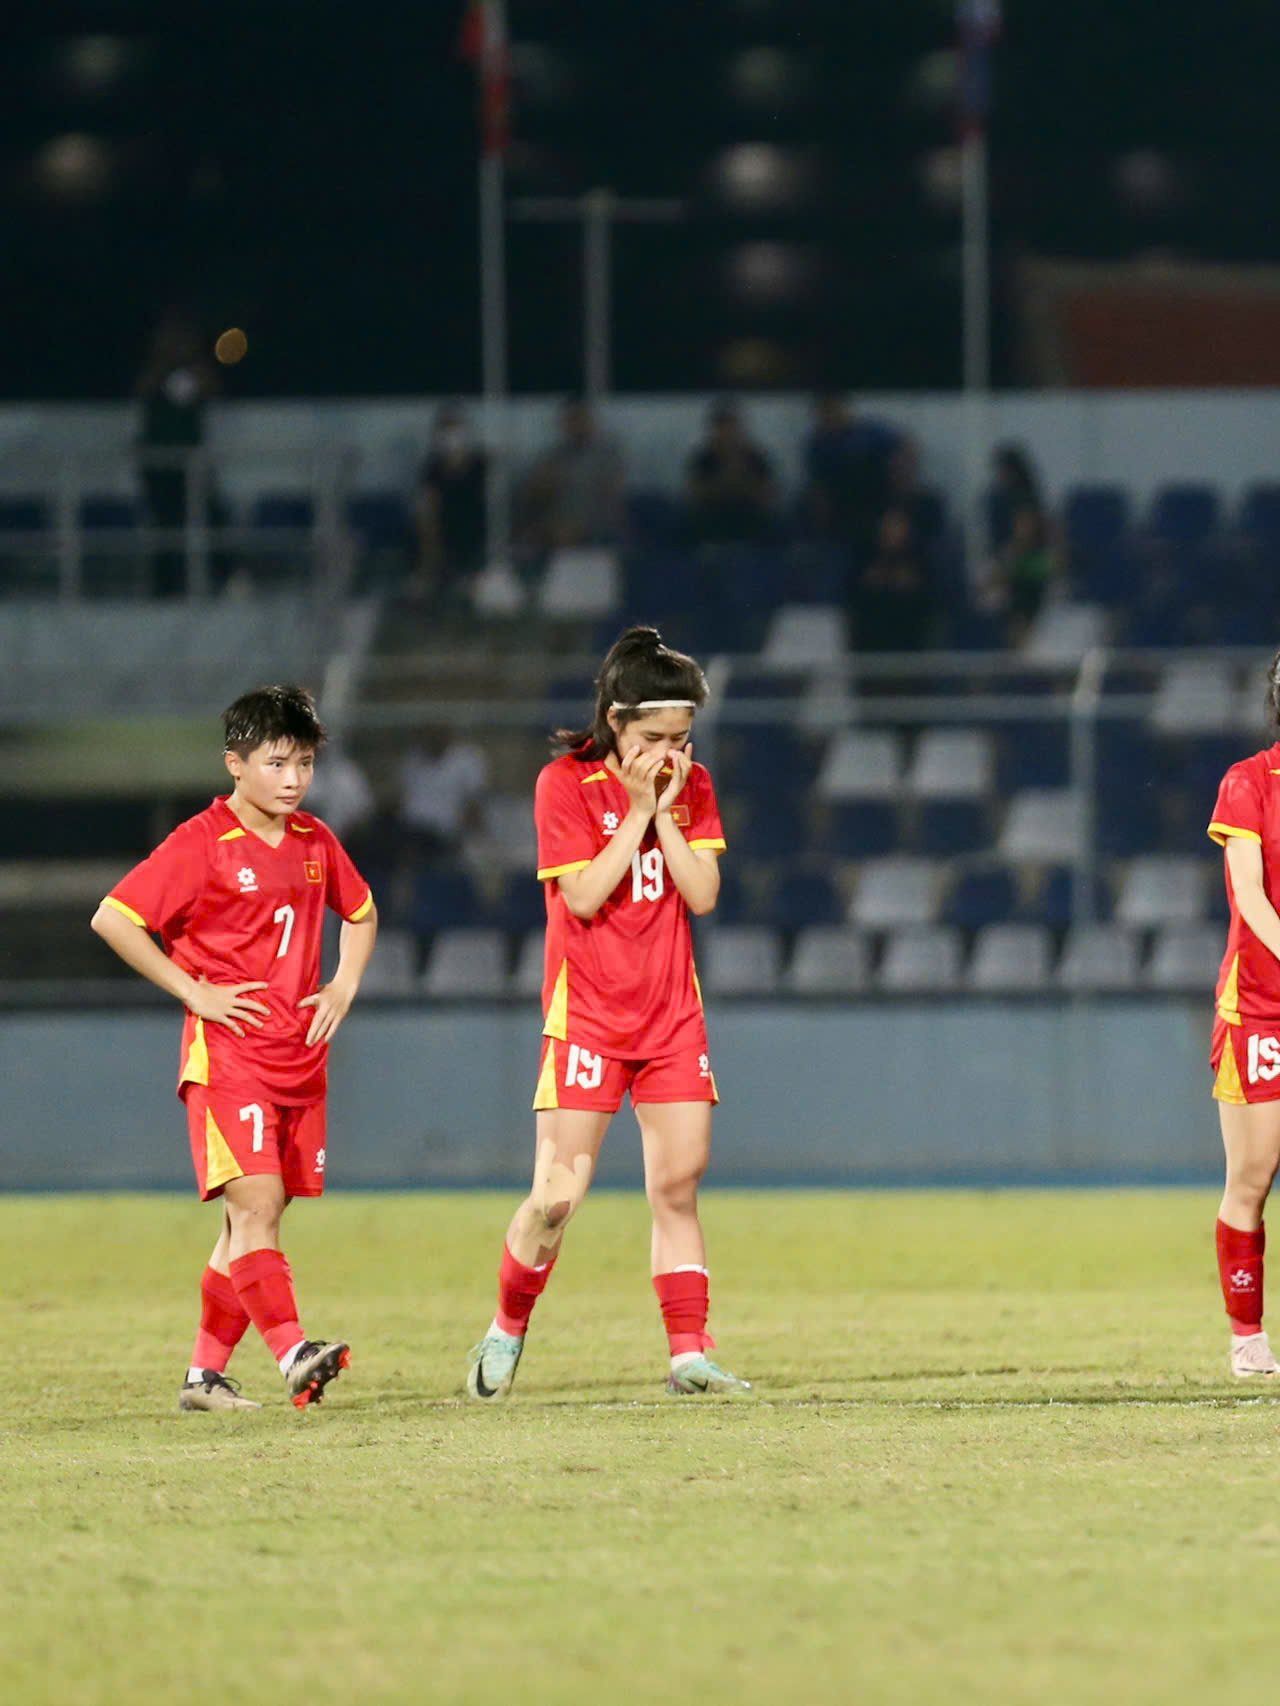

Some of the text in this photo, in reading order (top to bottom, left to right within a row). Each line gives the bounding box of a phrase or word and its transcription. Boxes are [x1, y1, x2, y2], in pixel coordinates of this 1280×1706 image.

[632, 847, 664, 903] 19
[274, 904, 295, 958] 7
[564, 1043, 603, 1090] 19
[239, 1103, 265, 1153] 7
